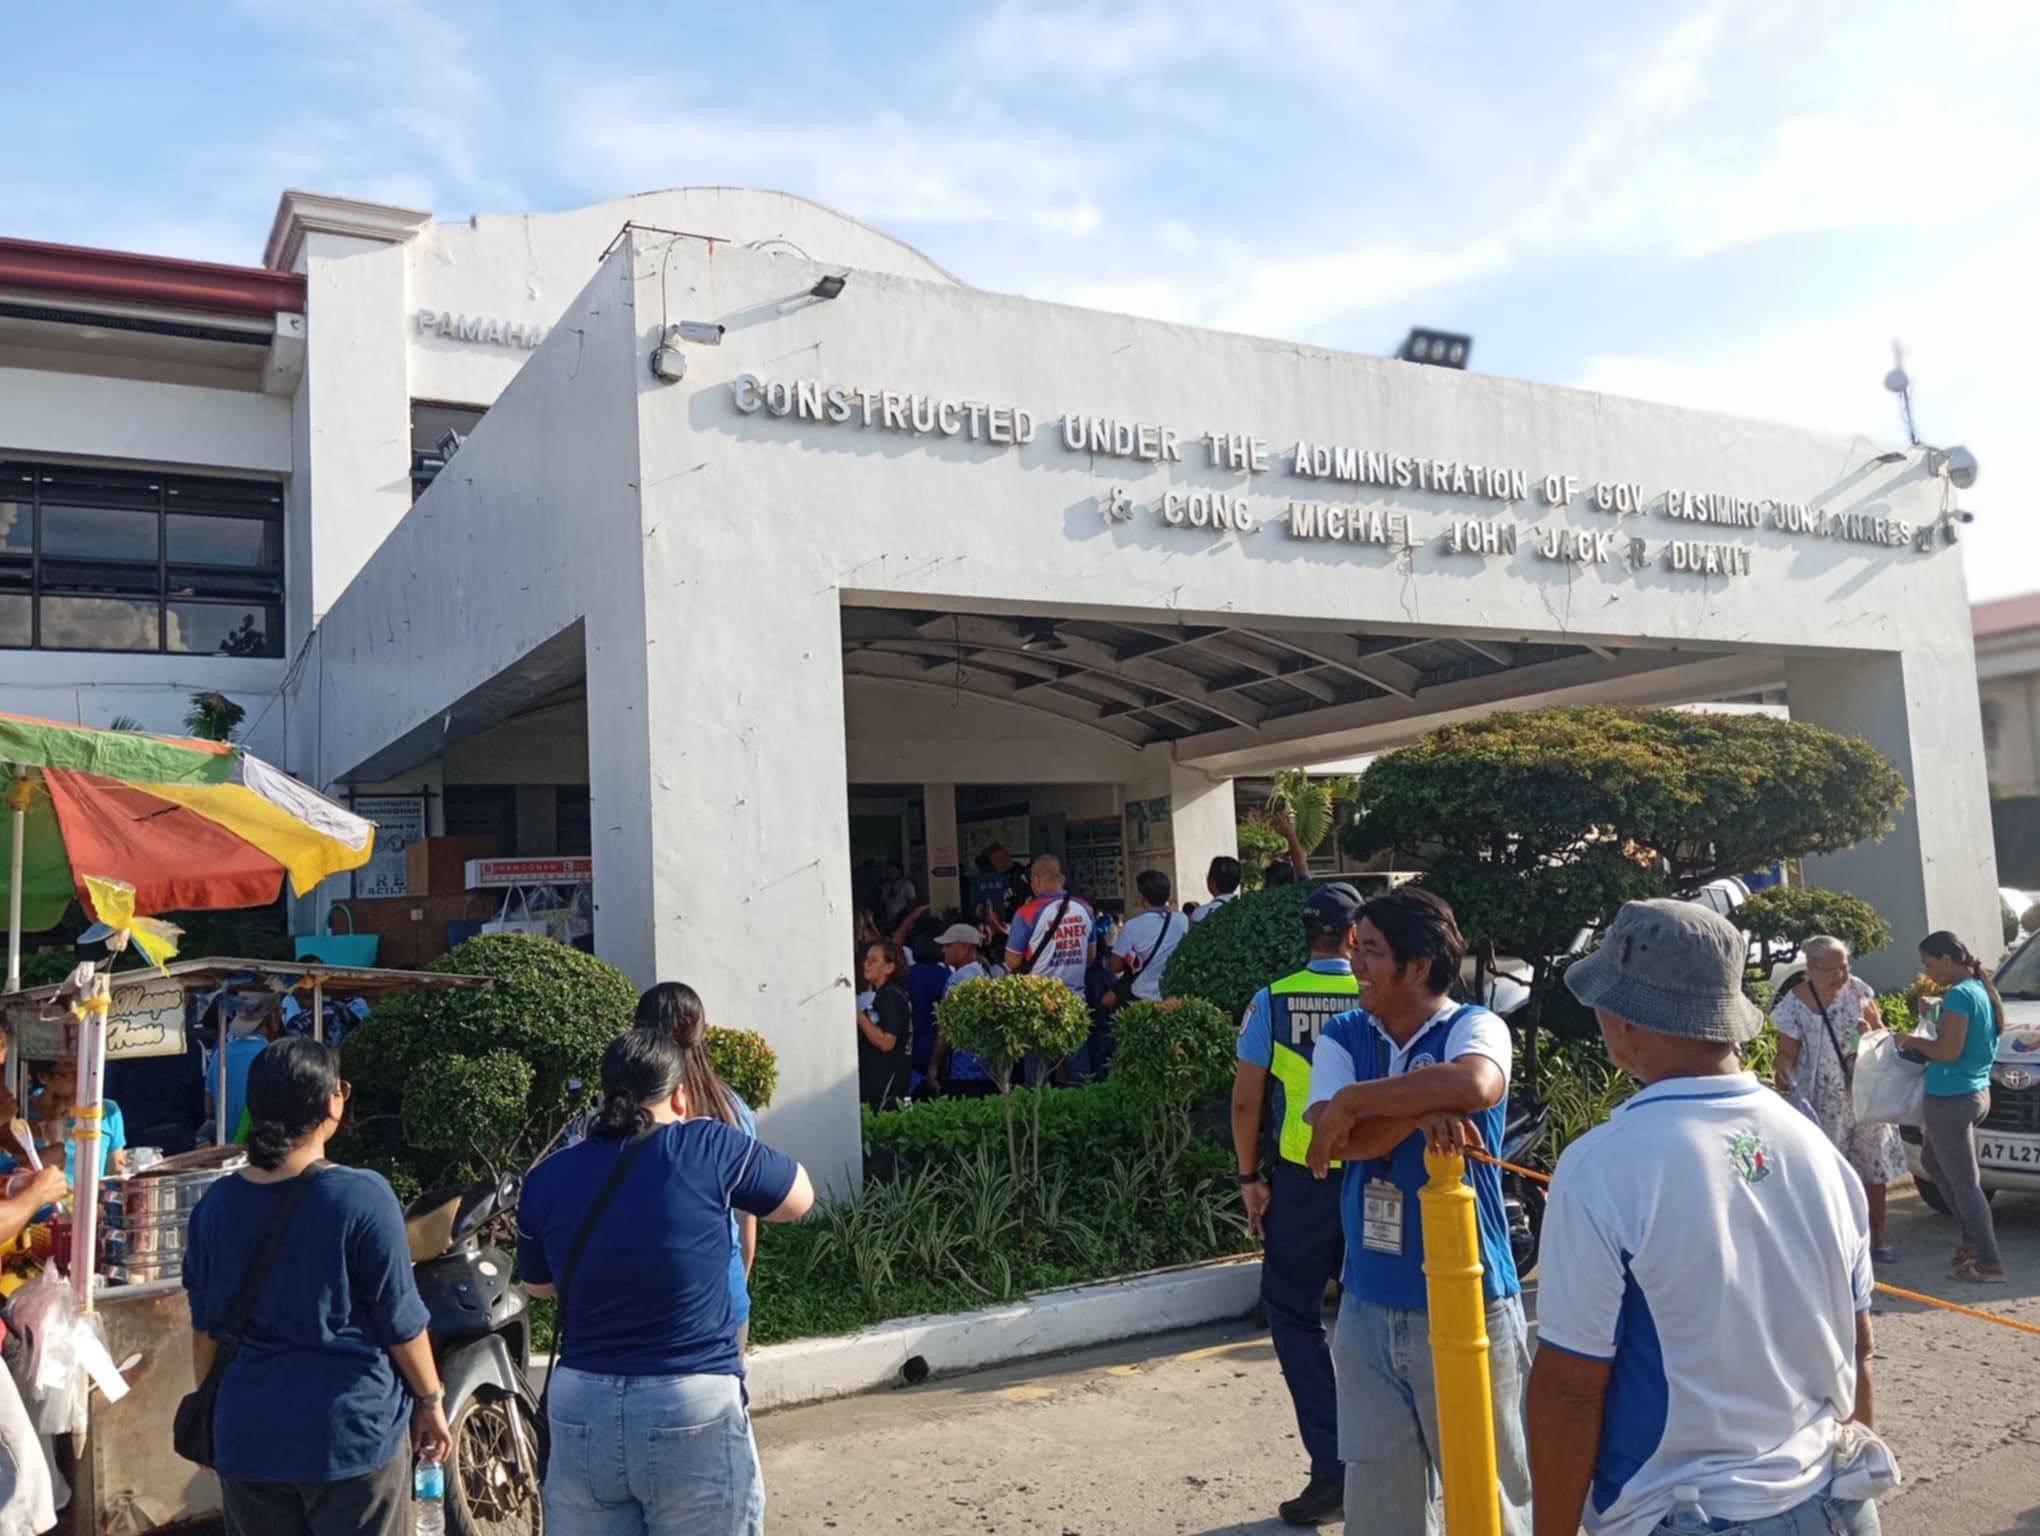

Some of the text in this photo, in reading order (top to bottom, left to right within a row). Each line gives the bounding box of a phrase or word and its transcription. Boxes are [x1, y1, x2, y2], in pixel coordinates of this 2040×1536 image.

[417, 309, 552, 350] PAMAHA
[735, 371, 1036, 443] CONSTRUCTED
[1061, 414, 1181, 462] UNDER
[1204, 432, 1269, 471] THE
[1294, 441, 1527, 500] ADMINISTRATION
[1545, 474, 1579, 505] OF
[1668, 489, 1762, 527] CASIMIRO
[1839, 512, 1910, 545] YNARES
[1111, 487, 1134, 520] &
[1163, 490, 1262, 533] CONG.
[1289, 502, 1424, 548] MICHAEL
[1451, 520, 1517, 556] JOHN
[1671, 540, 1752, 576] DUAVIT
